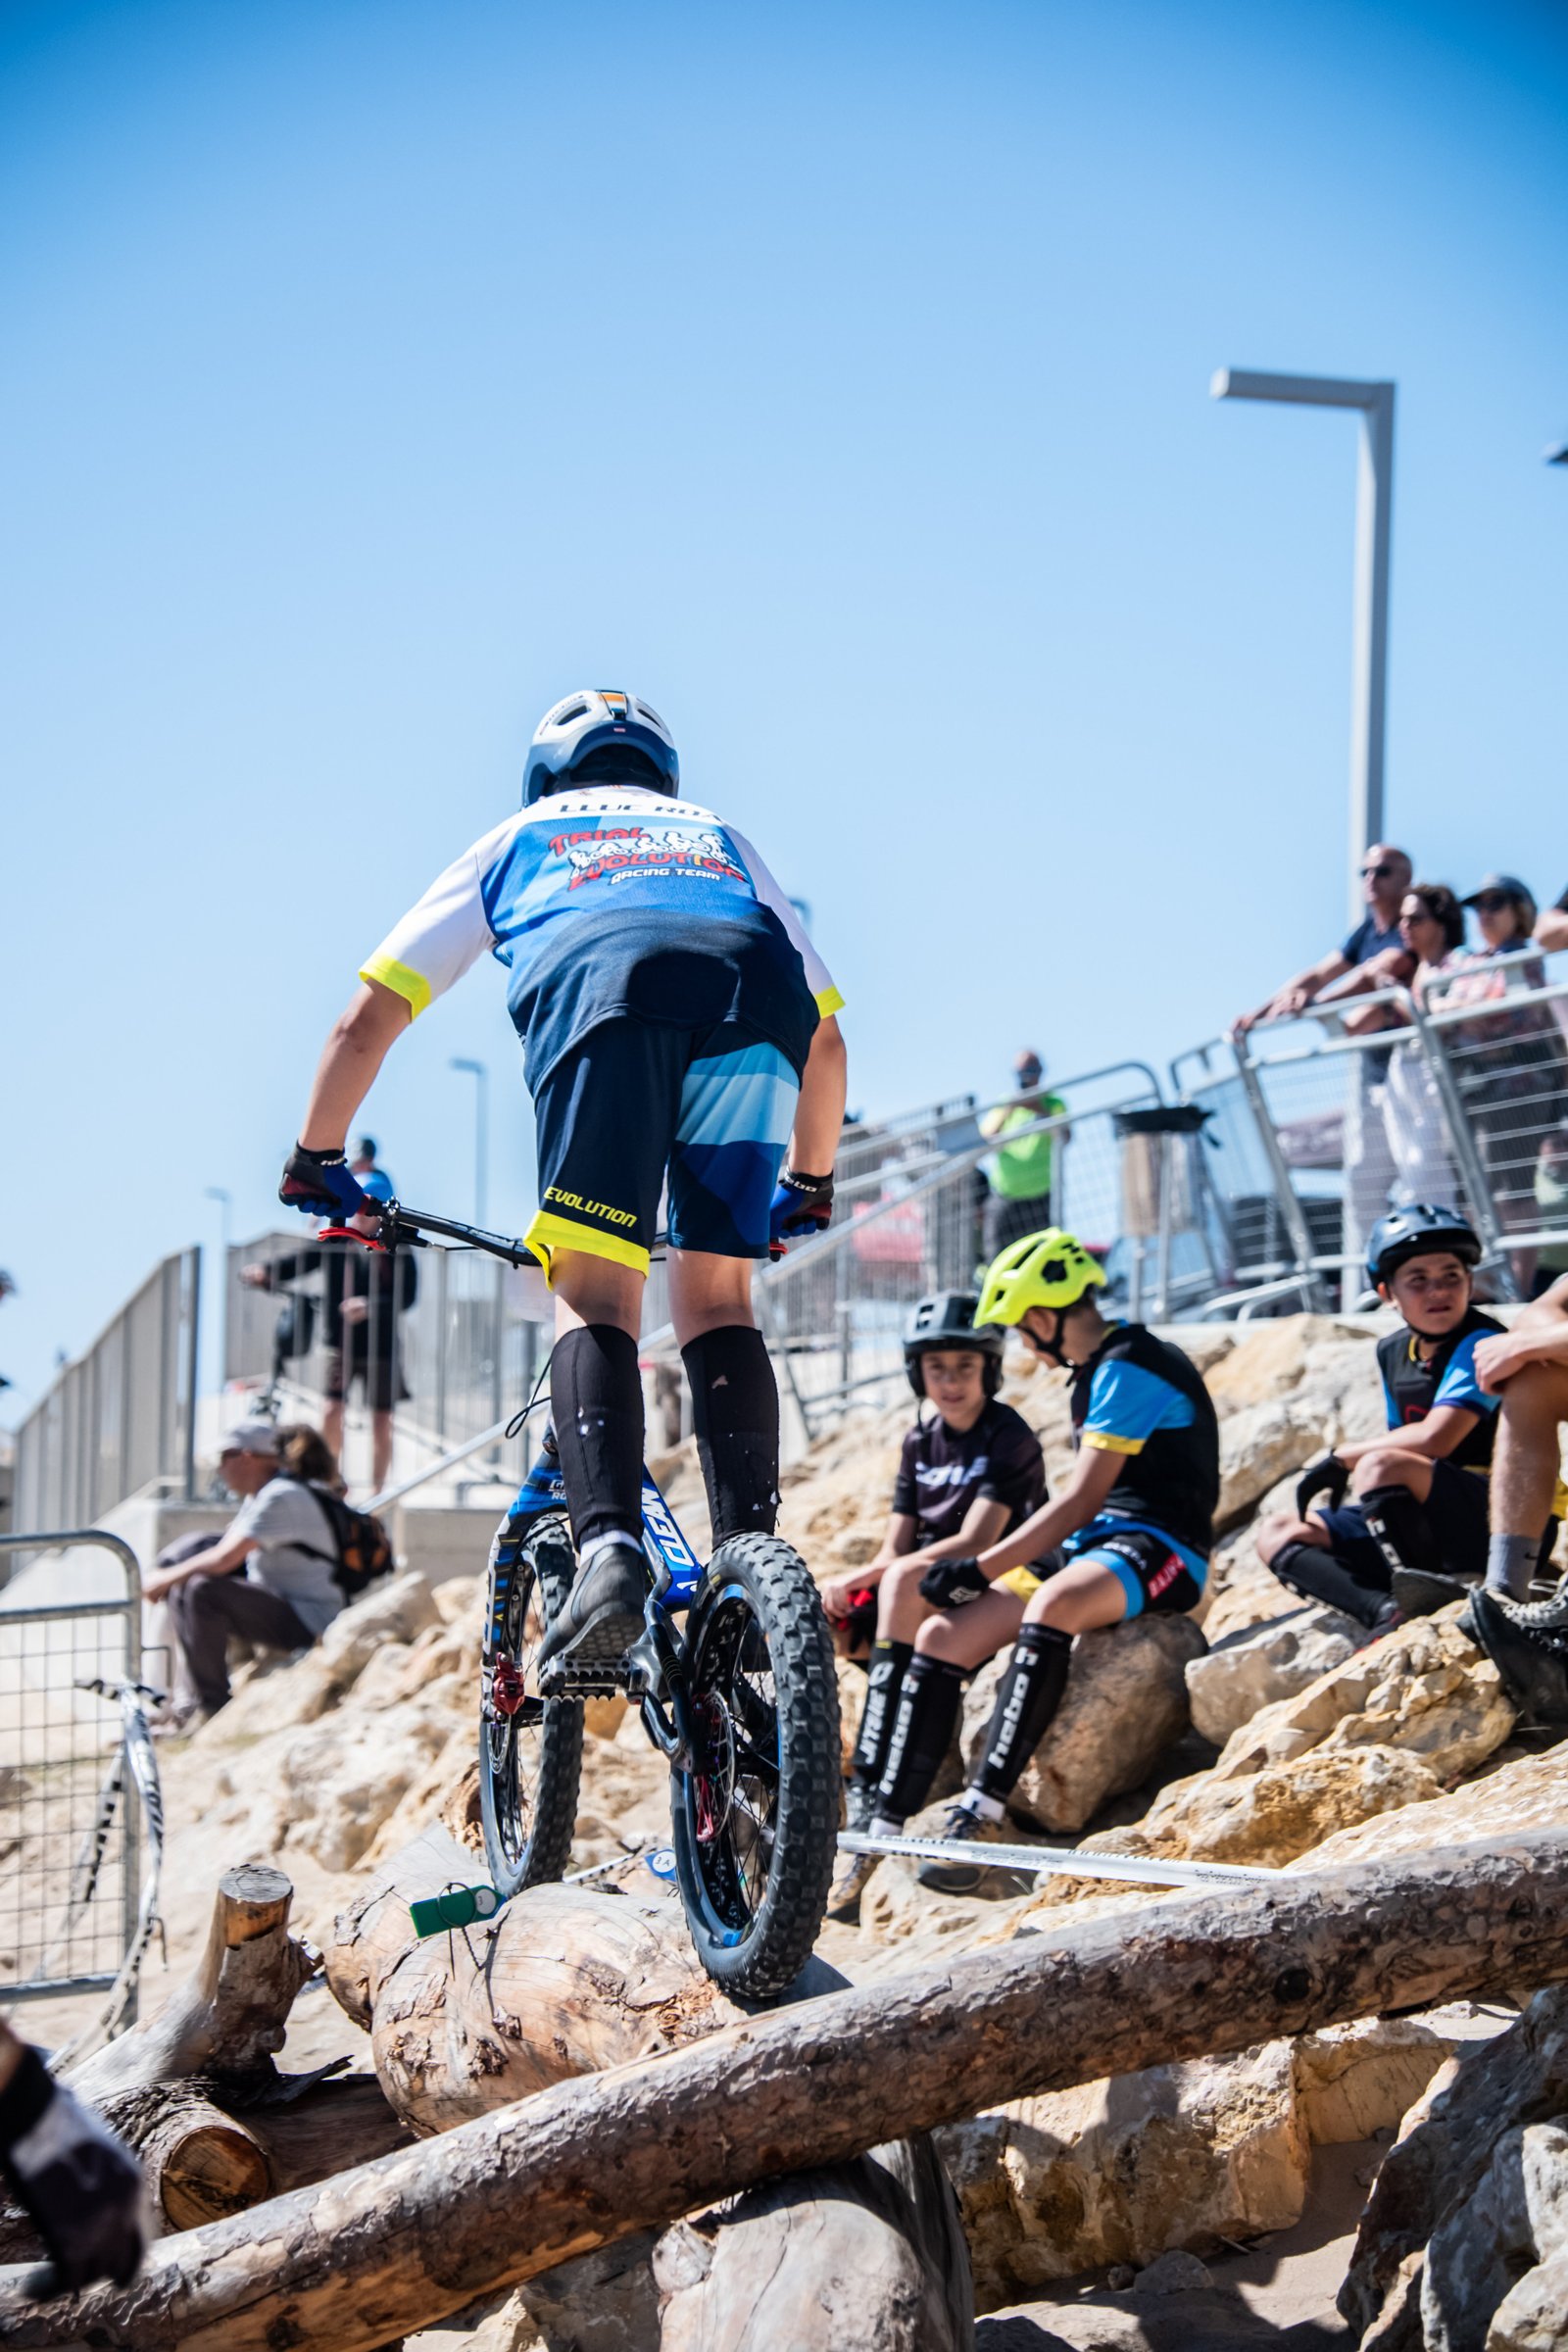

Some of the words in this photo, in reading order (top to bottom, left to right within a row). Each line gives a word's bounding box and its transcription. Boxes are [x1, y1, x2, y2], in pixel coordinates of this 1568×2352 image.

[549, 826, 649, 858] TRIAL
[610, 867, 670, 885] RACING
[674, 867, 721, 882] TEAM
[543, 1186, 637, 1228] EVOLUTION
[641, 1487, 695, 1567] CLEAN
[879, 1699, 913, 1795] hebo
[988, 1672, 1030, 1770] hebo
